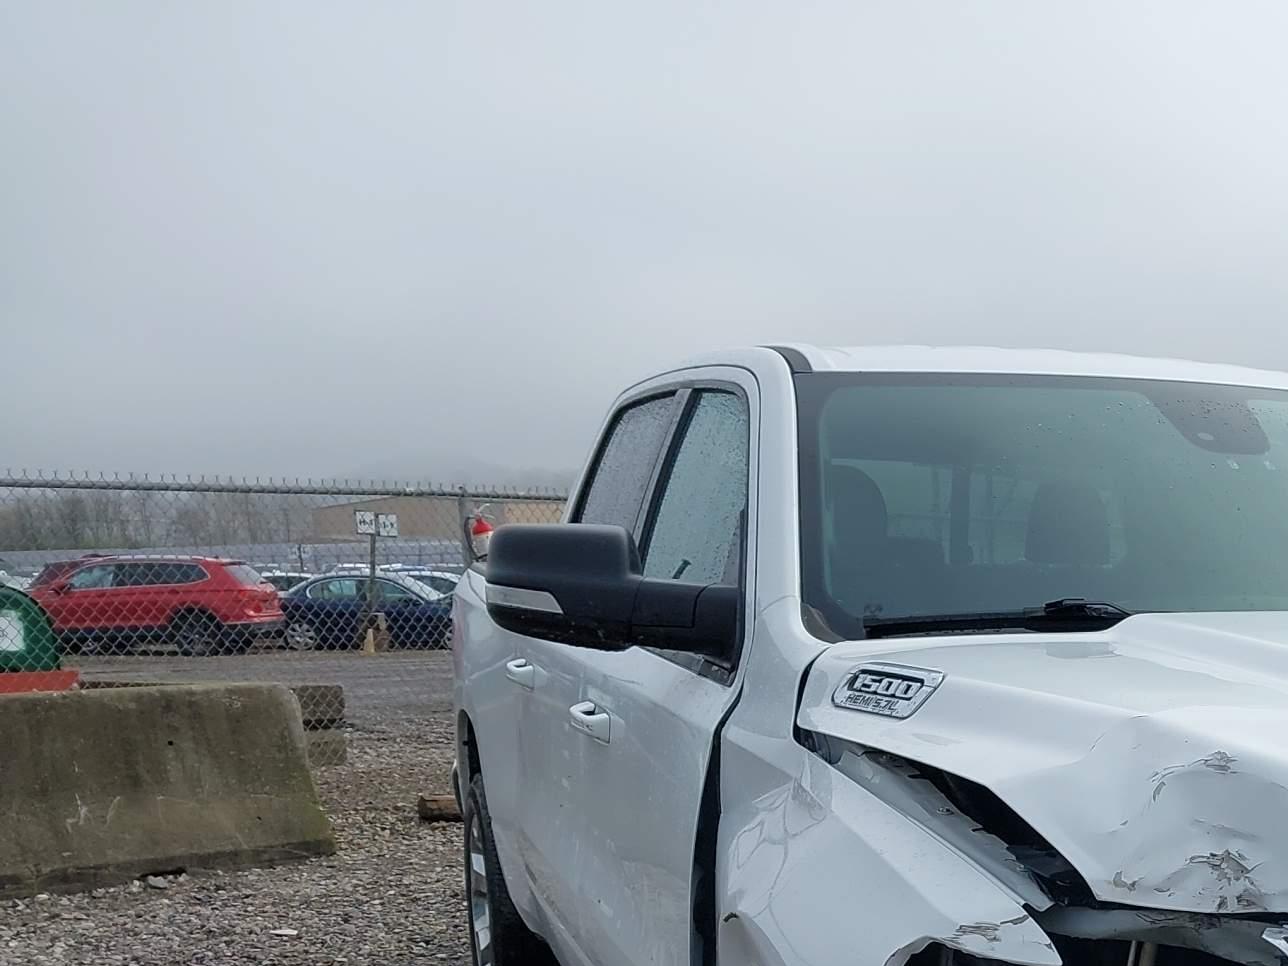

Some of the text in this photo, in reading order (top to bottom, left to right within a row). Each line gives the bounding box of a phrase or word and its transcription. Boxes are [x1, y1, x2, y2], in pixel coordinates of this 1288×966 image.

[853, 673, 922, 699] 1500
[845, 693, 900, 711] HEMI 5.7L
